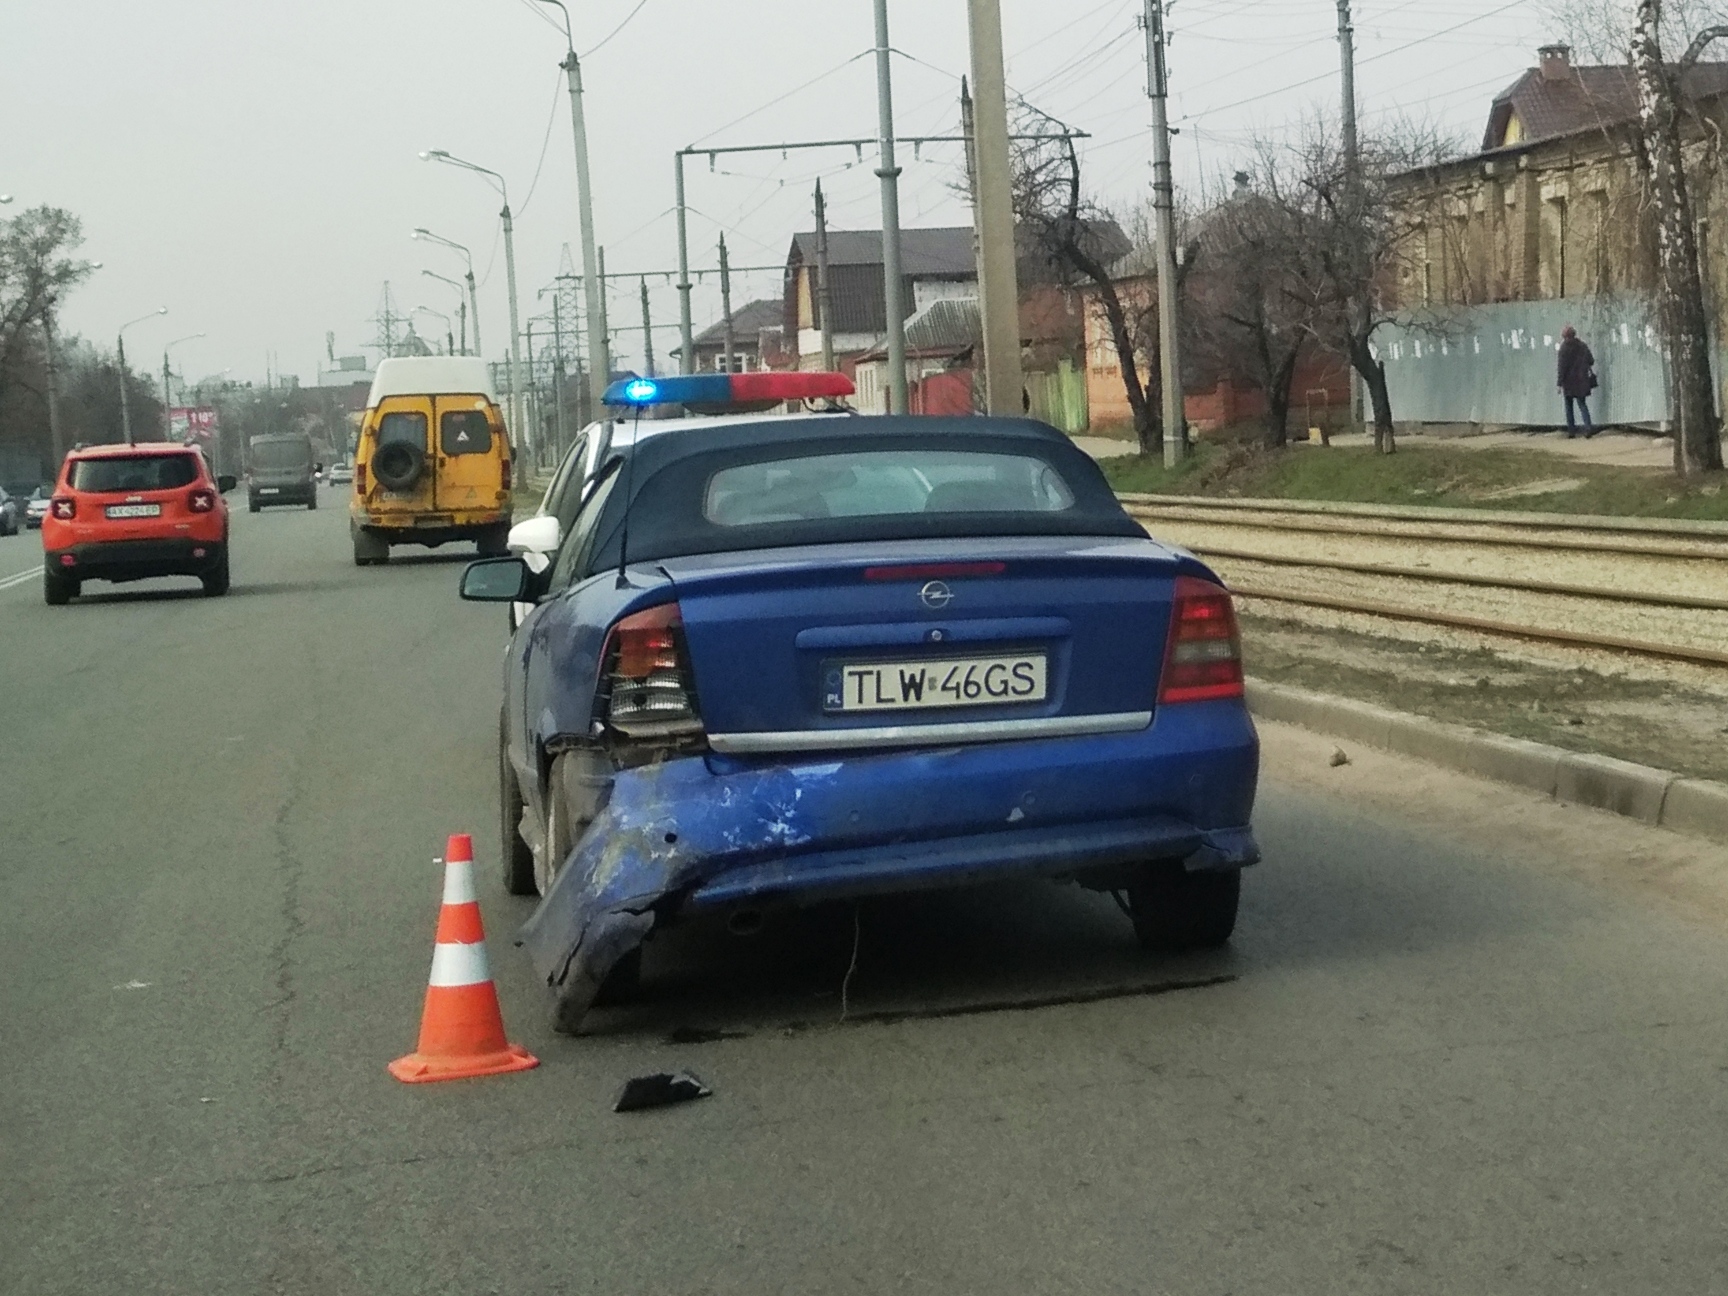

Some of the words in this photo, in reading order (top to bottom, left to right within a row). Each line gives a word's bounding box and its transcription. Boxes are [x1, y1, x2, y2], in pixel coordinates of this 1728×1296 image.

[847, 669, 926, 704] TLW
[940, 662, 1035, 699] 46GS
[827, 693, 841, 703] PL
